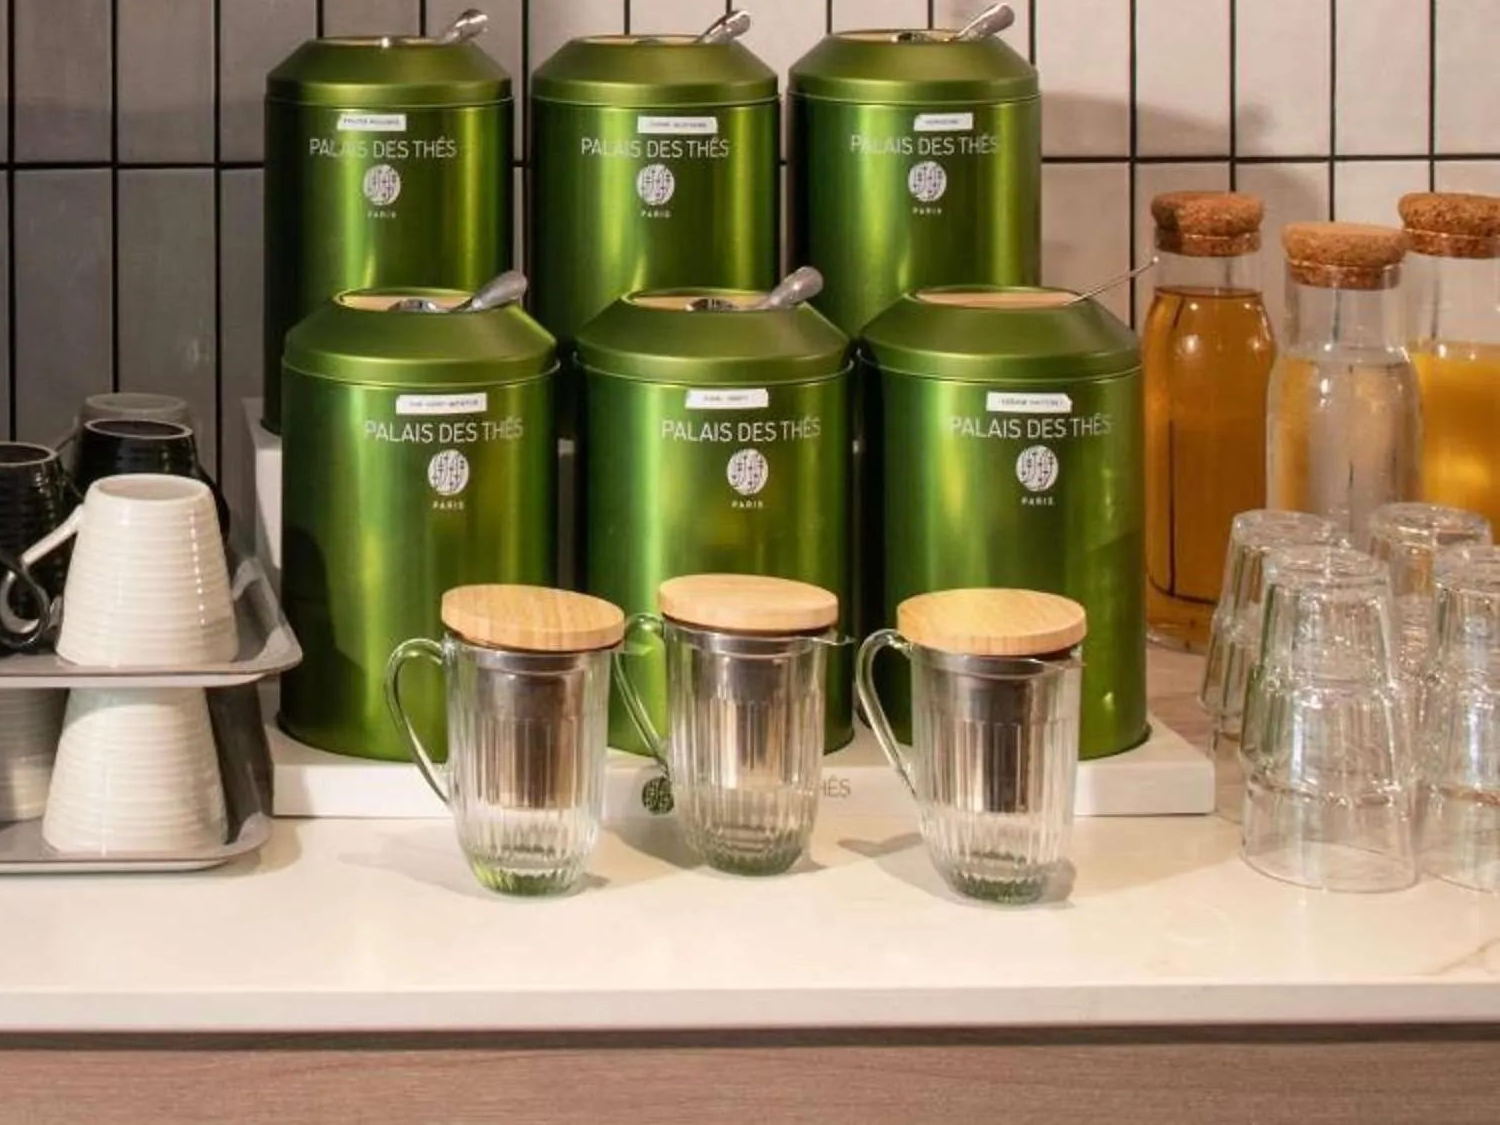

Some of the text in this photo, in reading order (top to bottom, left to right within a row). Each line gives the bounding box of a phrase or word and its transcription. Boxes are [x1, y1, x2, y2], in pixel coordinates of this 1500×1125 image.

[308, 135, 457, 159] PALAIS DES THÉS
[581, 136, 730, 159] PALAIS DES THÉS
[851, 132, 1000, 156] PALAIS DES THÉS
[364, 416, 524, 444] PALAIS DES THÉS
[661, 415, 822, 442] PALAIS DES THÉS
[950, 412, 1113, 439] PALAIS DES THÉS
[432, 500, 465, 511] PARIS
